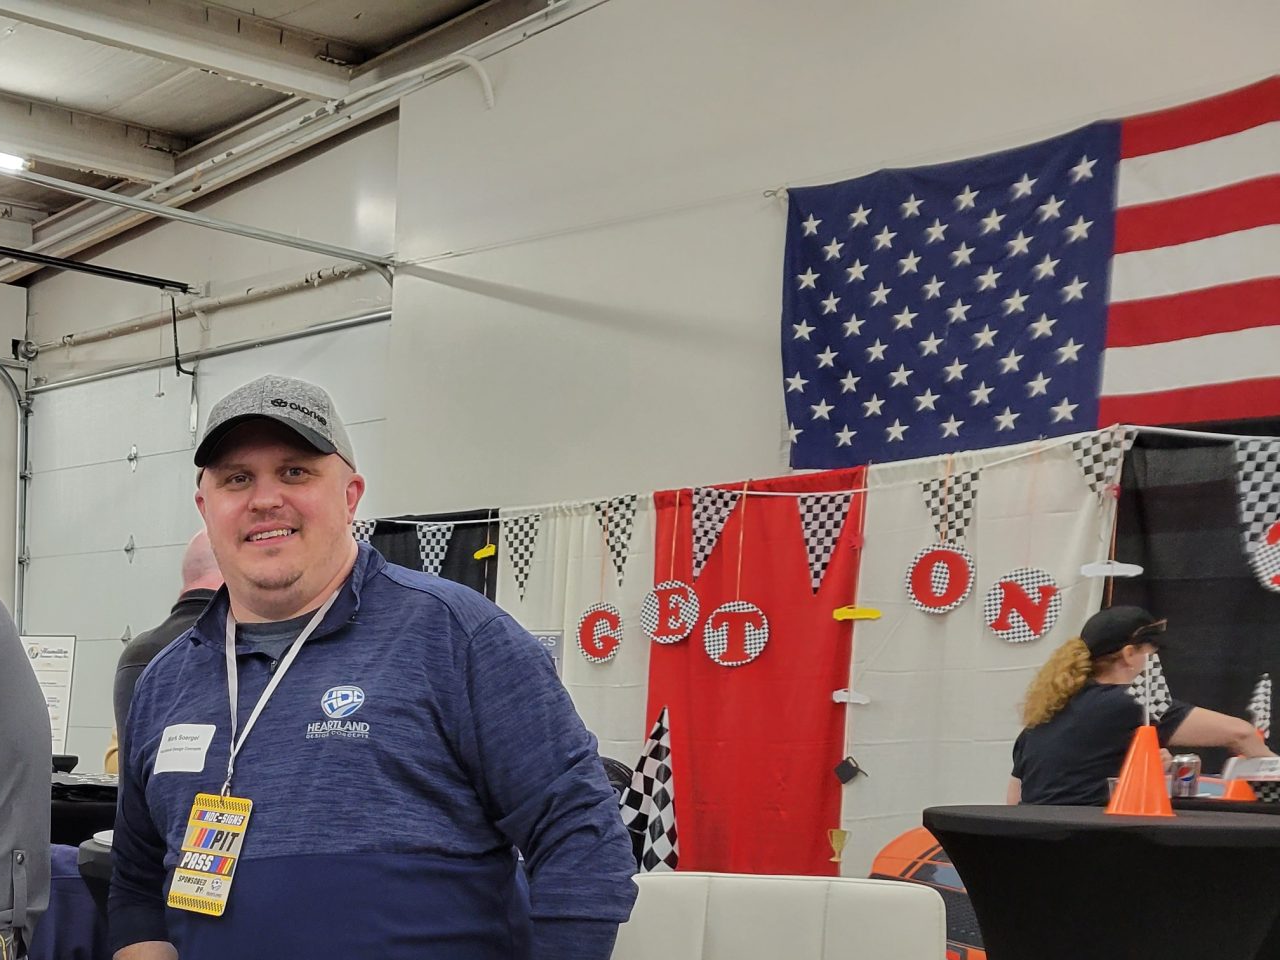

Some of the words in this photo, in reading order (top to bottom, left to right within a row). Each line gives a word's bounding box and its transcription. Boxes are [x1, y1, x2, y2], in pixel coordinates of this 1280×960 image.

[307, 720, 370, 732] HEARTLAND
[204, 811, 245, 826] HDC-SIGNS
[209, 830, 240, 852] PIT
[180, 851, 215, 872] PASS
[177, 874, 208, 887] SPONSORED
